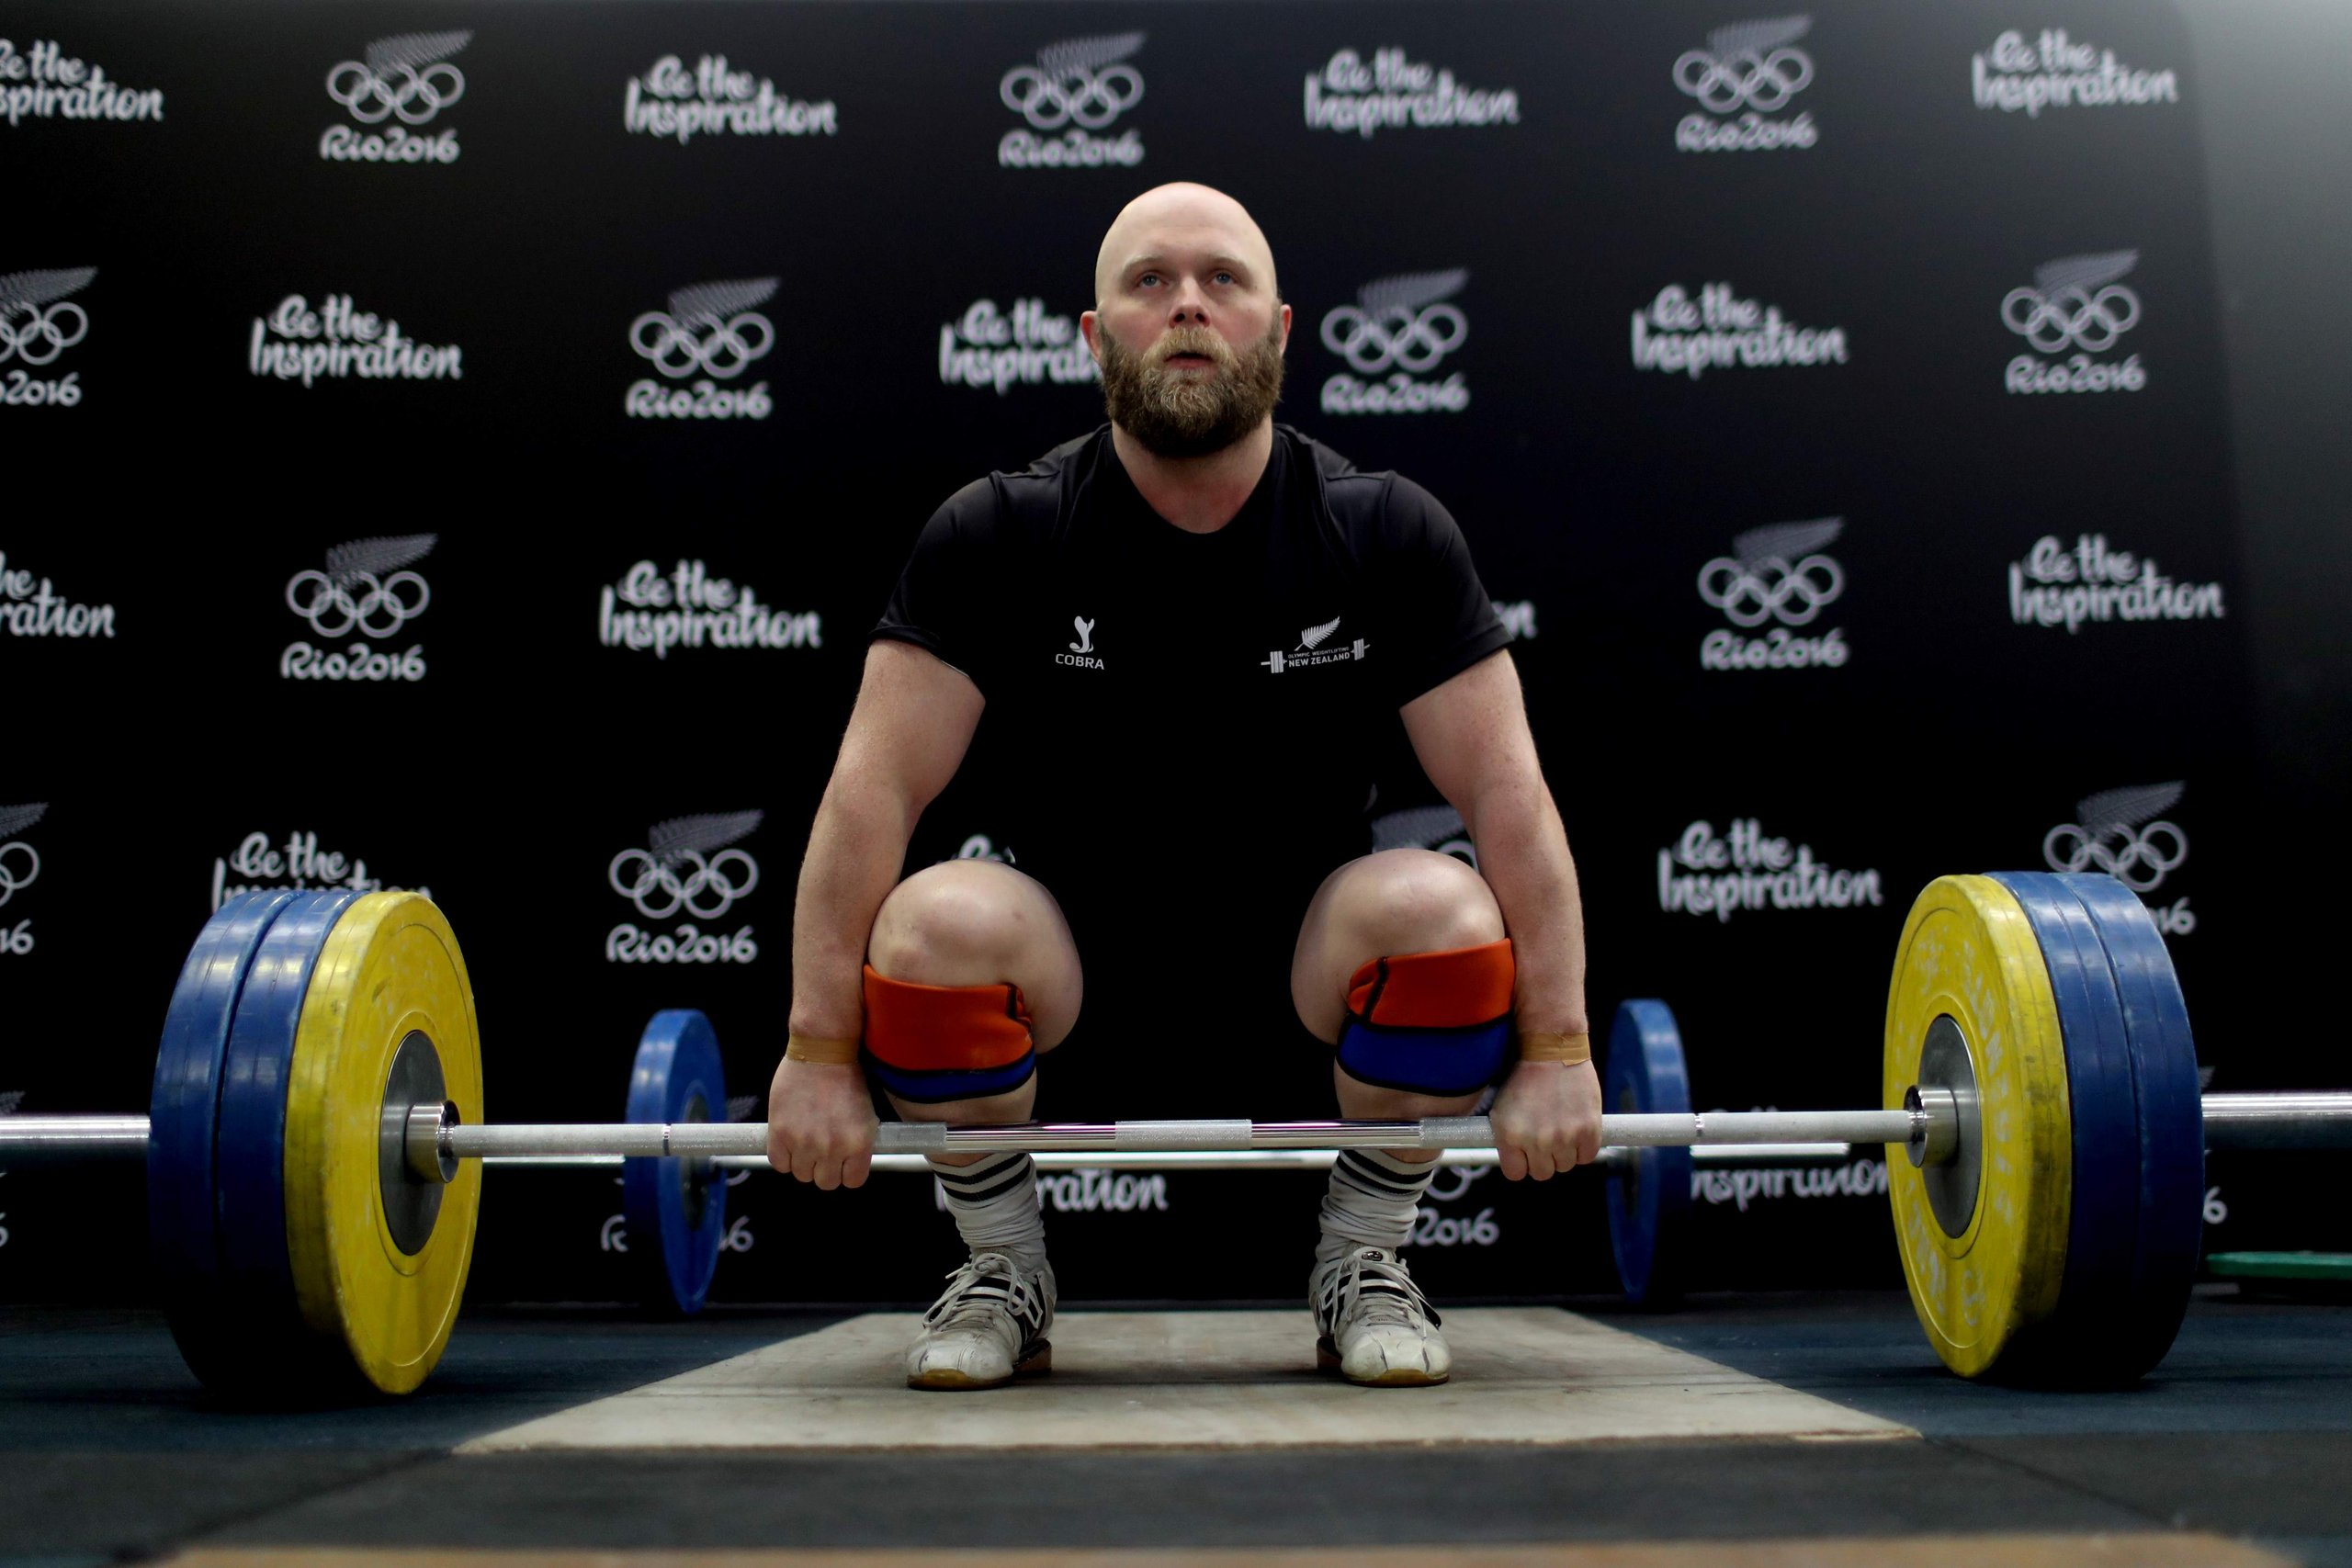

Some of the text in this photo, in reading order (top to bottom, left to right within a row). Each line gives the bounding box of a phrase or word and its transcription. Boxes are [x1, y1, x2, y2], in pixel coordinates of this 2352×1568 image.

[27, 39, 88, 85] the
[1373, 47, 1438, 93] the
[2038, 28, 2099, 73] the
[692, 54, 756, 100] the
[1973, 51, 2177, 117] Inspiration
[624, 77, 837, 144] Inspiration
[1304, 70, 1520, 137] Inspiration
[320, 124, 460, 164] Rio2016
[998, 129, 1145, 167] Rio2016
[1676, 112, 1818, 152] Rio2016
[317, 294, 381, 342] the
[1008, 299, 1073, 347] the
[1700, 282, 1765, 332] the
[249, 318, 462, 388] Inspiration
[1631, 306, 1848, 378] Inspiration
[1320, 372, 1470, 414] Rio2016
[2005, 355, 2146, 394] Rio2016
[625, 378, 773, 419] Rio2016
[2077, 534, 2143, 585] the
[670, 559, 738, 610] the
[2008, 558, 2224, 634] Inspiration
[599, 584, 822, 659] Inspiration
[280, 641, 426, 682] Rio2016
[1056, 653, 1104, 671] COBRA
[1288, 652, 1351, 668] NEW ZEALAND
[1701, 626, 1849, 671] Rio2016
[283, 830, 350, 884] the
[1729, 818, 1798, 872] the
[1657, 844, 1883, 922] Inspiration
[605, 923, 758, 964] Rio2016
